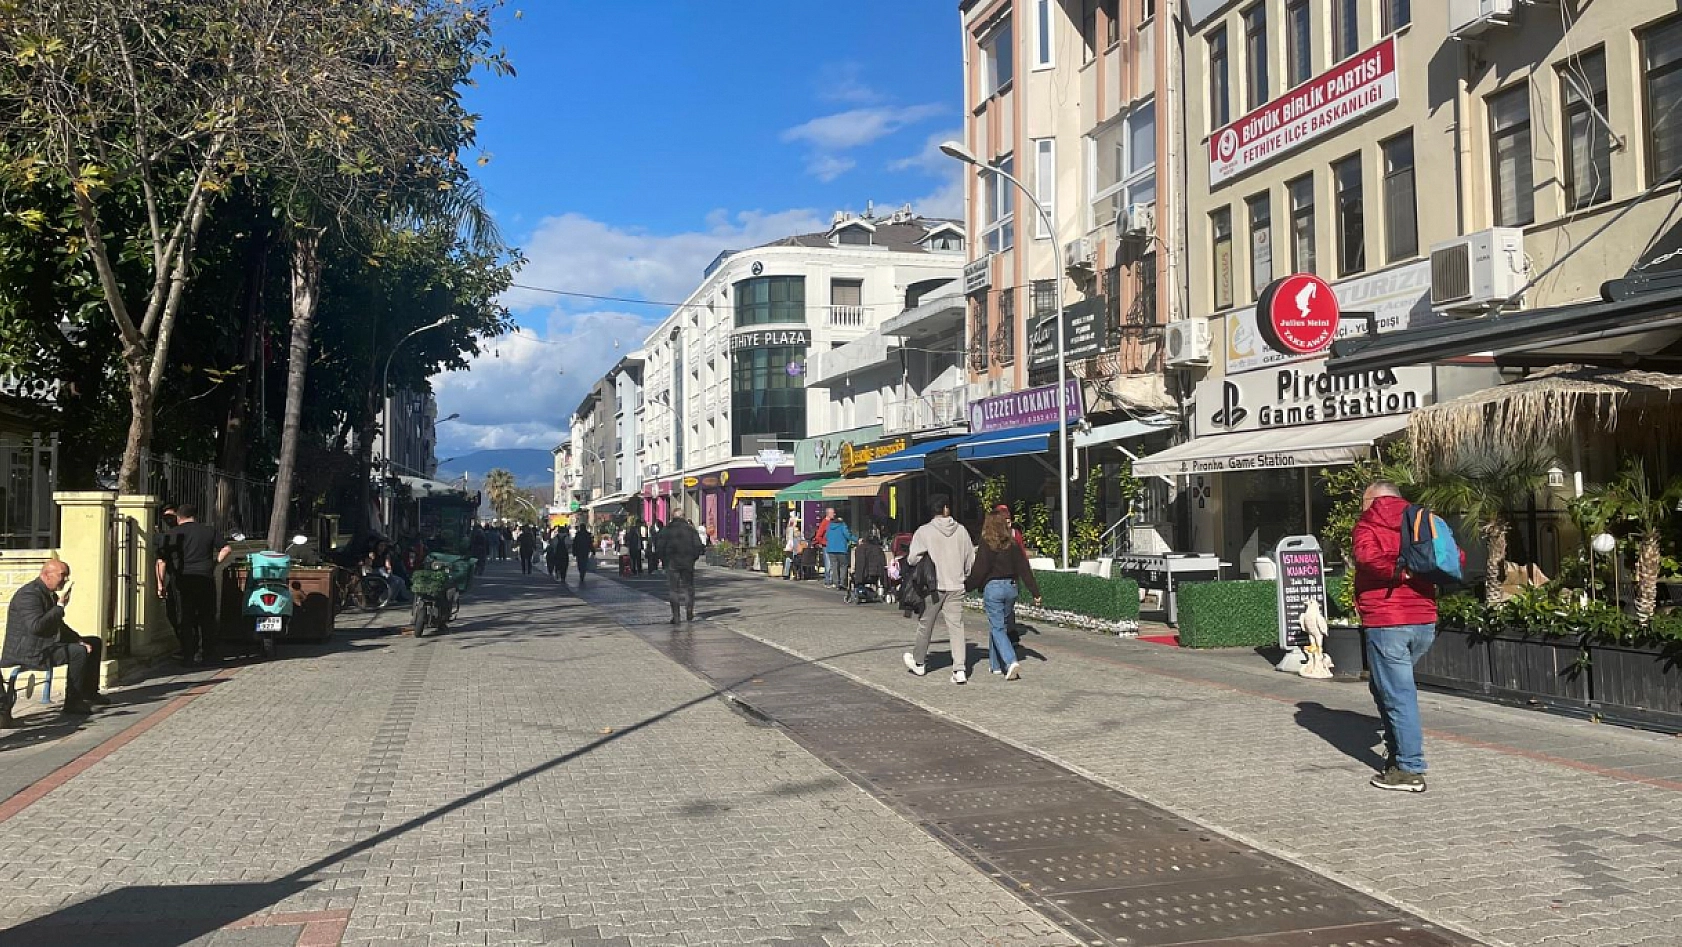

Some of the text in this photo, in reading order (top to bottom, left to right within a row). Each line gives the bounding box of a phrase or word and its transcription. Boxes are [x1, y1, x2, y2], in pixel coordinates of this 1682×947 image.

[1242, 51, 1381, 143] BÜYÜK BİRLİK PARTİSİ
[1243, 83, 1383, 164] FETHİYE İLÇE BAŞKANLIĞI
[764, 331, 806, 345] PLAZA
[1284, 329, 1304, 347] TAKE
[1307, 329, 1329, 347] AWAY
[984, 398, 1015, 420] LEZZET
[1259, 389, 1417, 426] Game Station
[1193, 454, 1295, 471] Piranha Game Station
